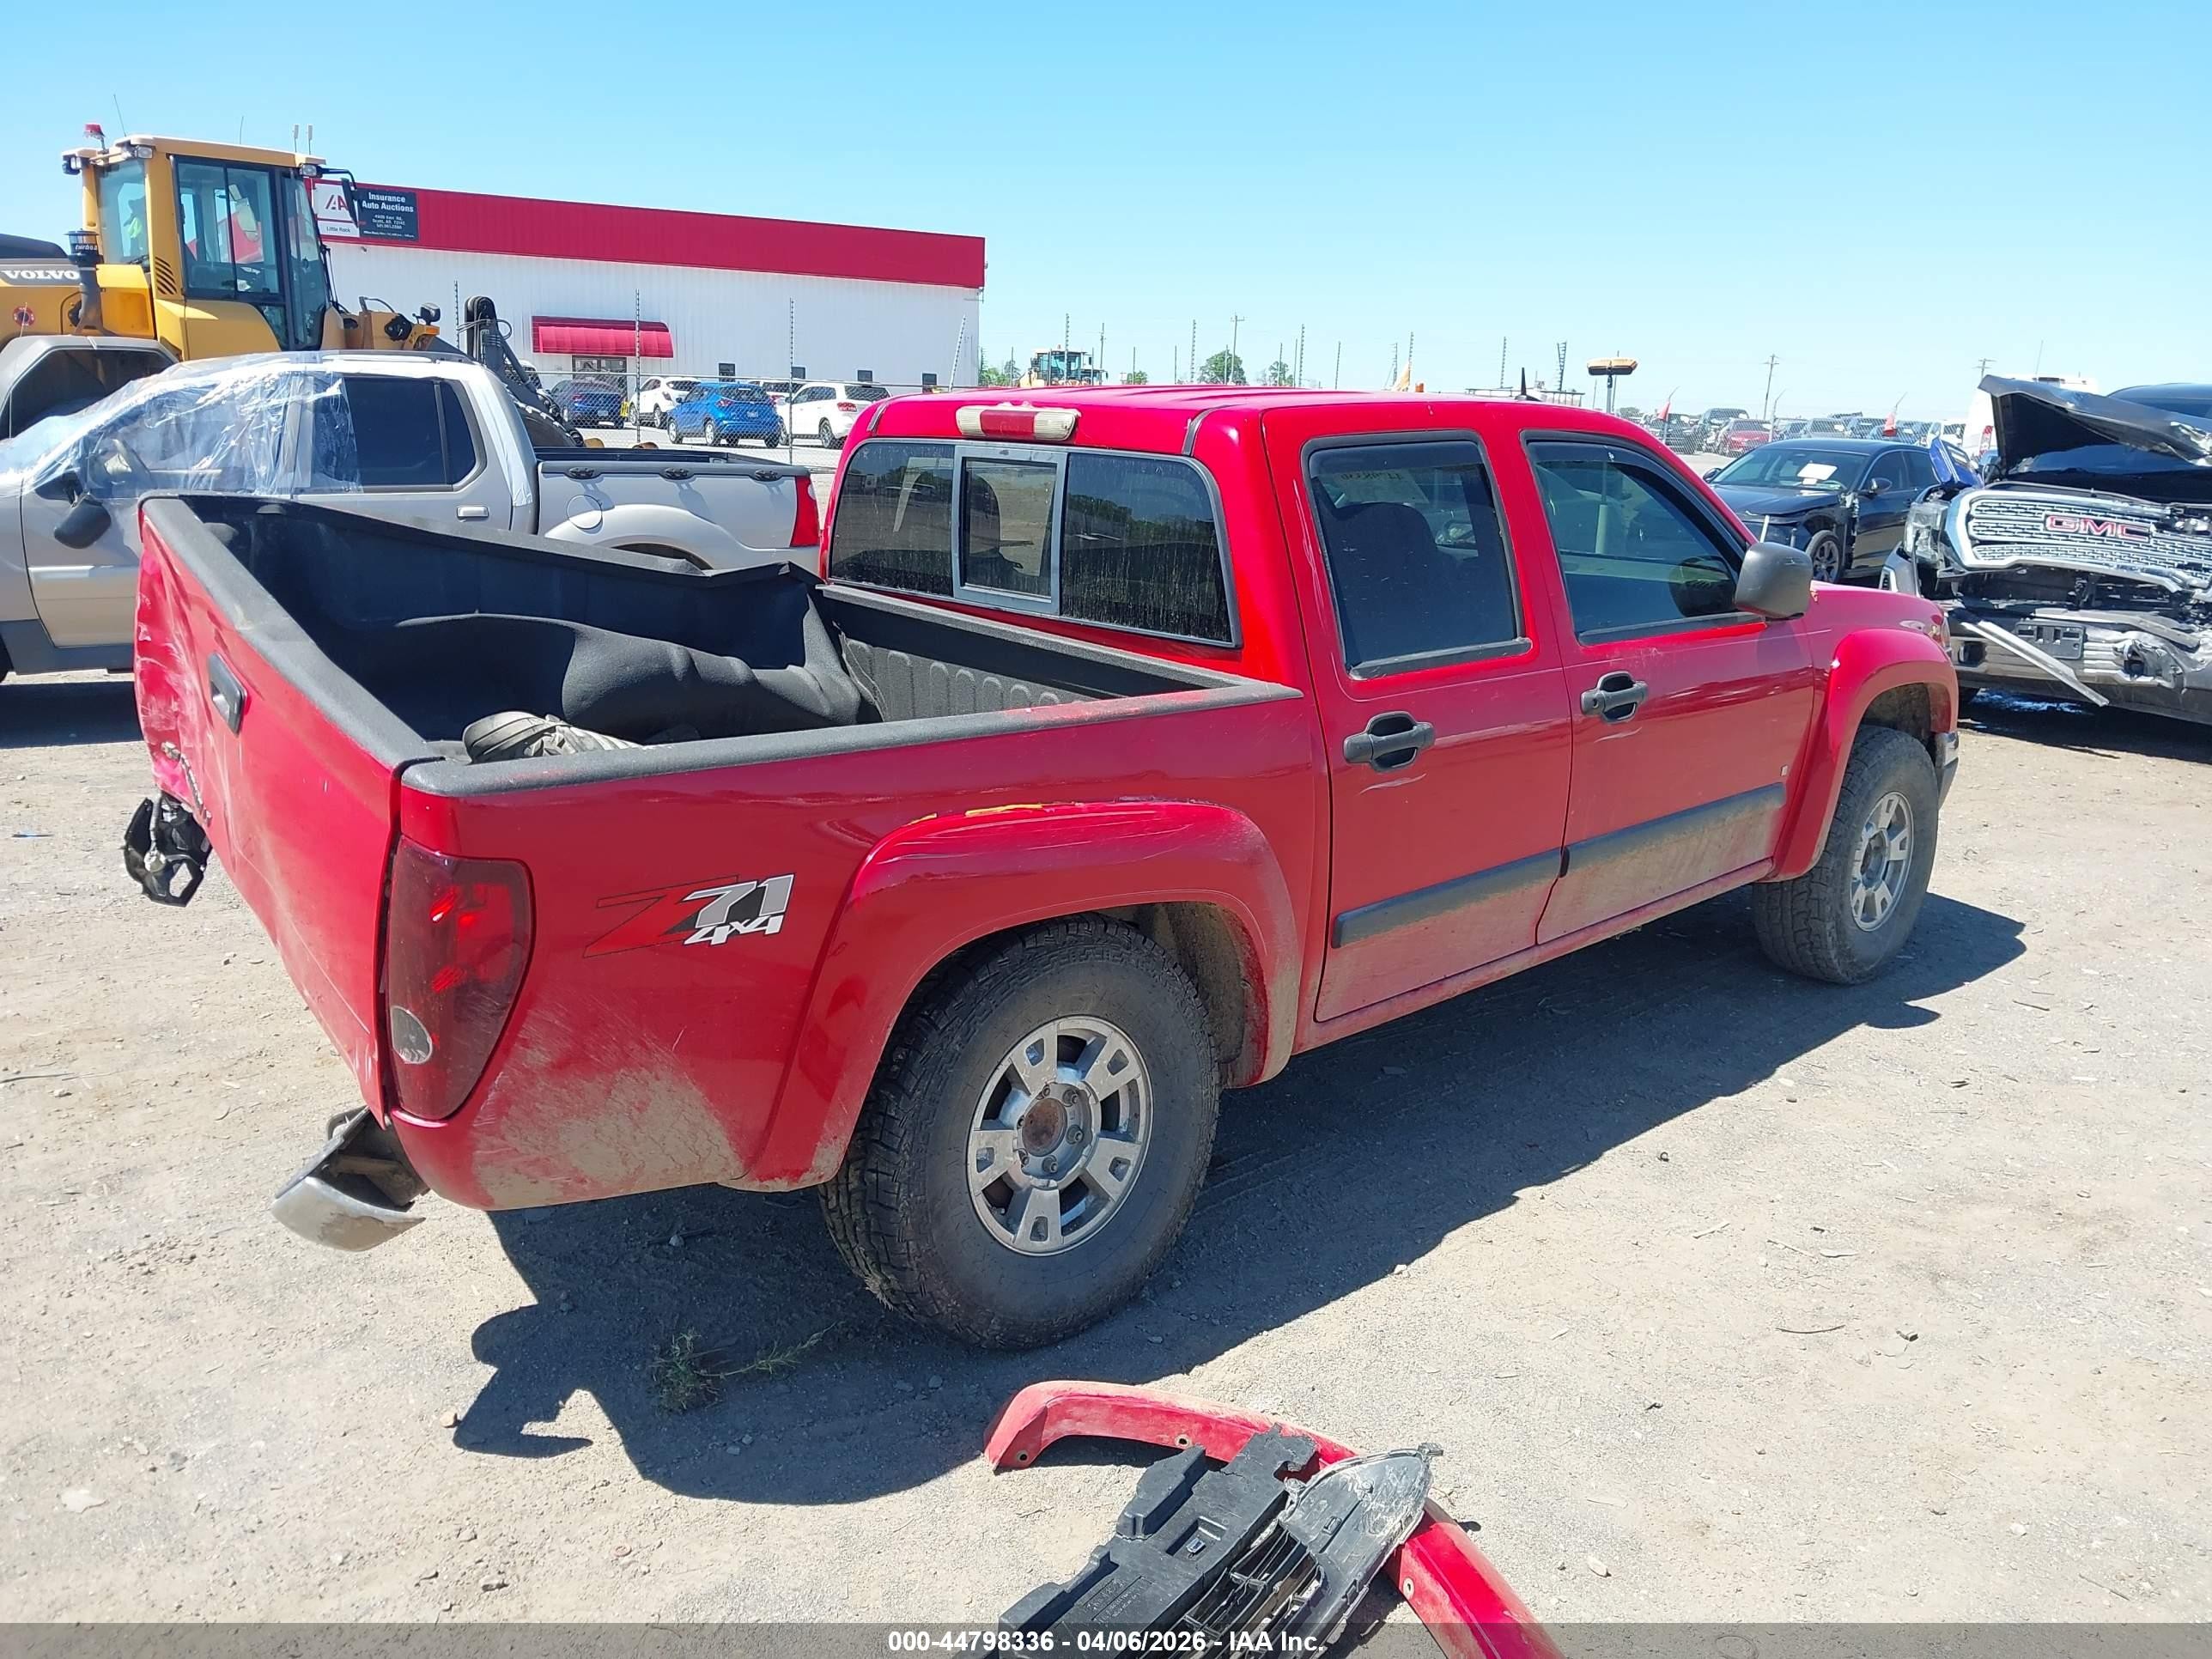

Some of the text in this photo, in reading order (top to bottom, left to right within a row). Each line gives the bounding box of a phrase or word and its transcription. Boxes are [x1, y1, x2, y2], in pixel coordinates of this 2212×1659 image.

[368, 192, 406, 203] Insurance
[362, 200, 414, 213] Auto Auctions
[1, 270, 81, 280] VOLVO
[2045, 515, 2149, 542] GMC
